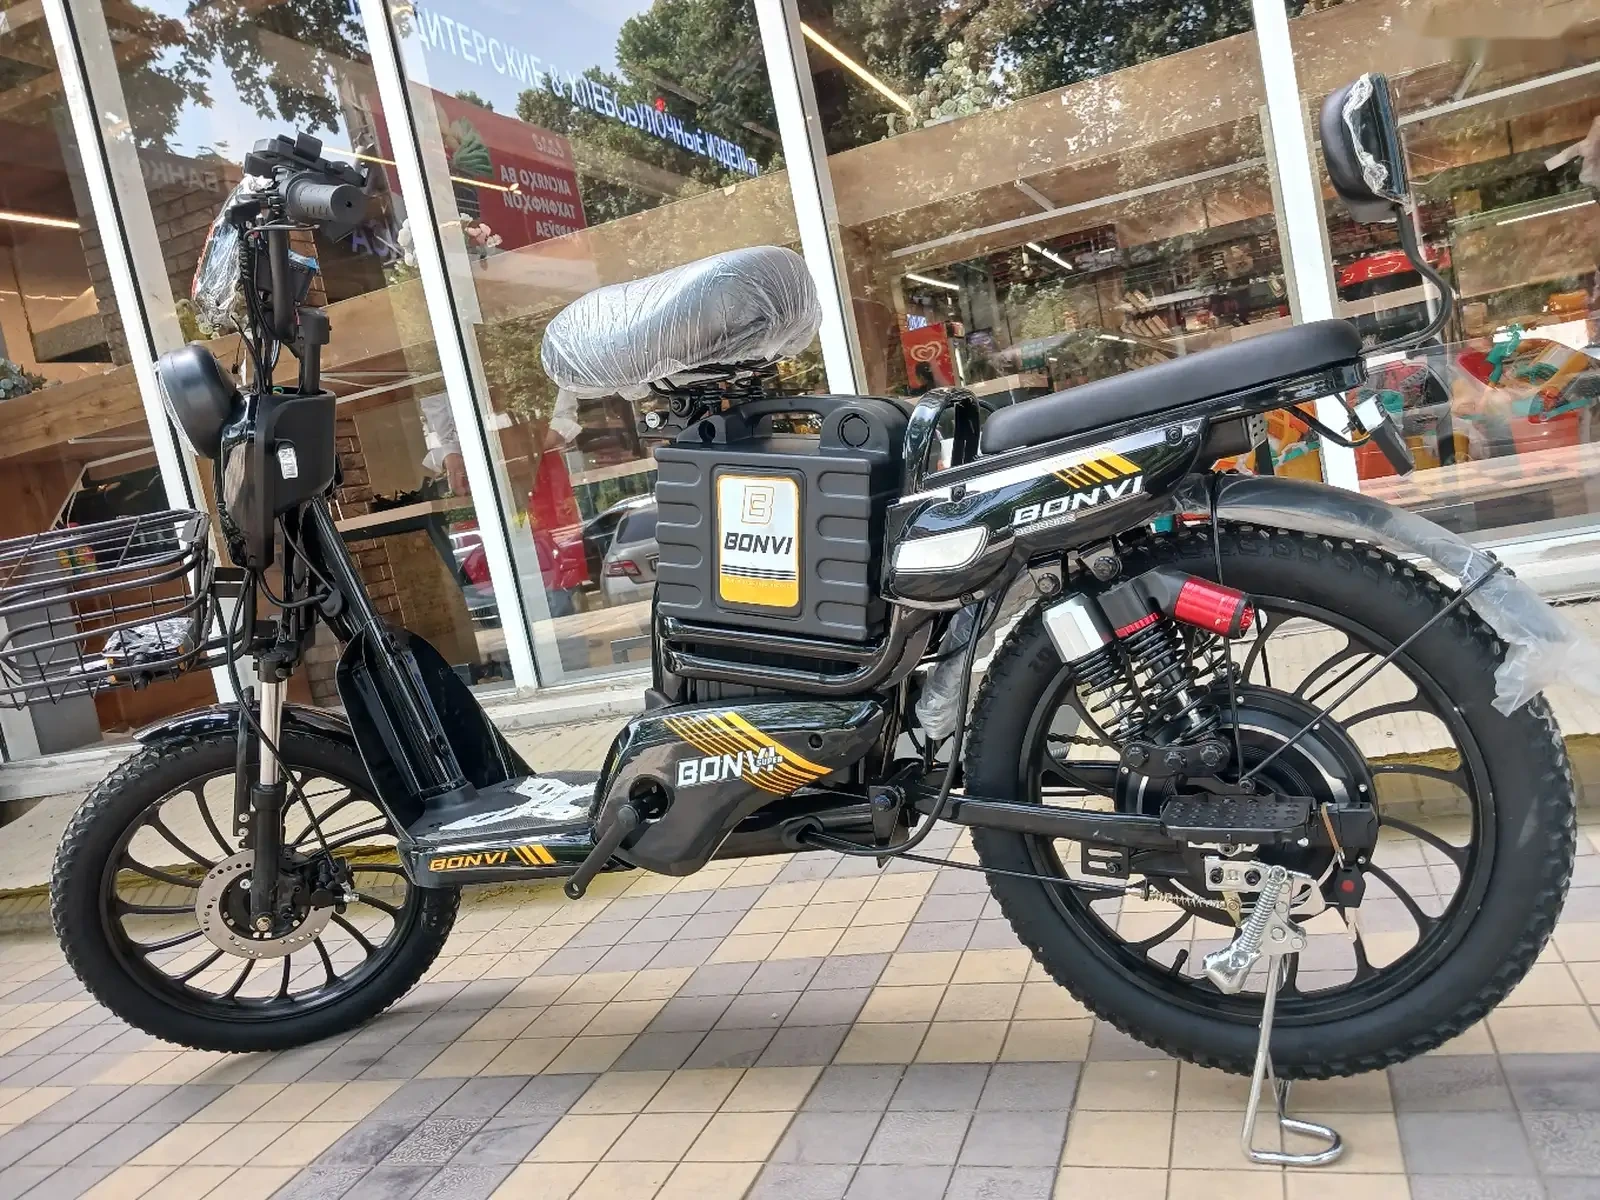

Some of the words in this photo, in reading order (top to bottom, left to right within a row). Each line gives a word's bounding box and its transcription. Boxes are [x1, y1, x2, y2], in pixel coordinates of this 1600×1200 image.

[549, 64, 566, 98] &
[1012, 475, 1144, 526] BONVI
[724, 531, 793, 556] BONVI
[677, 746, 776, 787] BONVI
[756, 755, 784, 767] SUPER
[430, 851, 508, 871] BONVI
